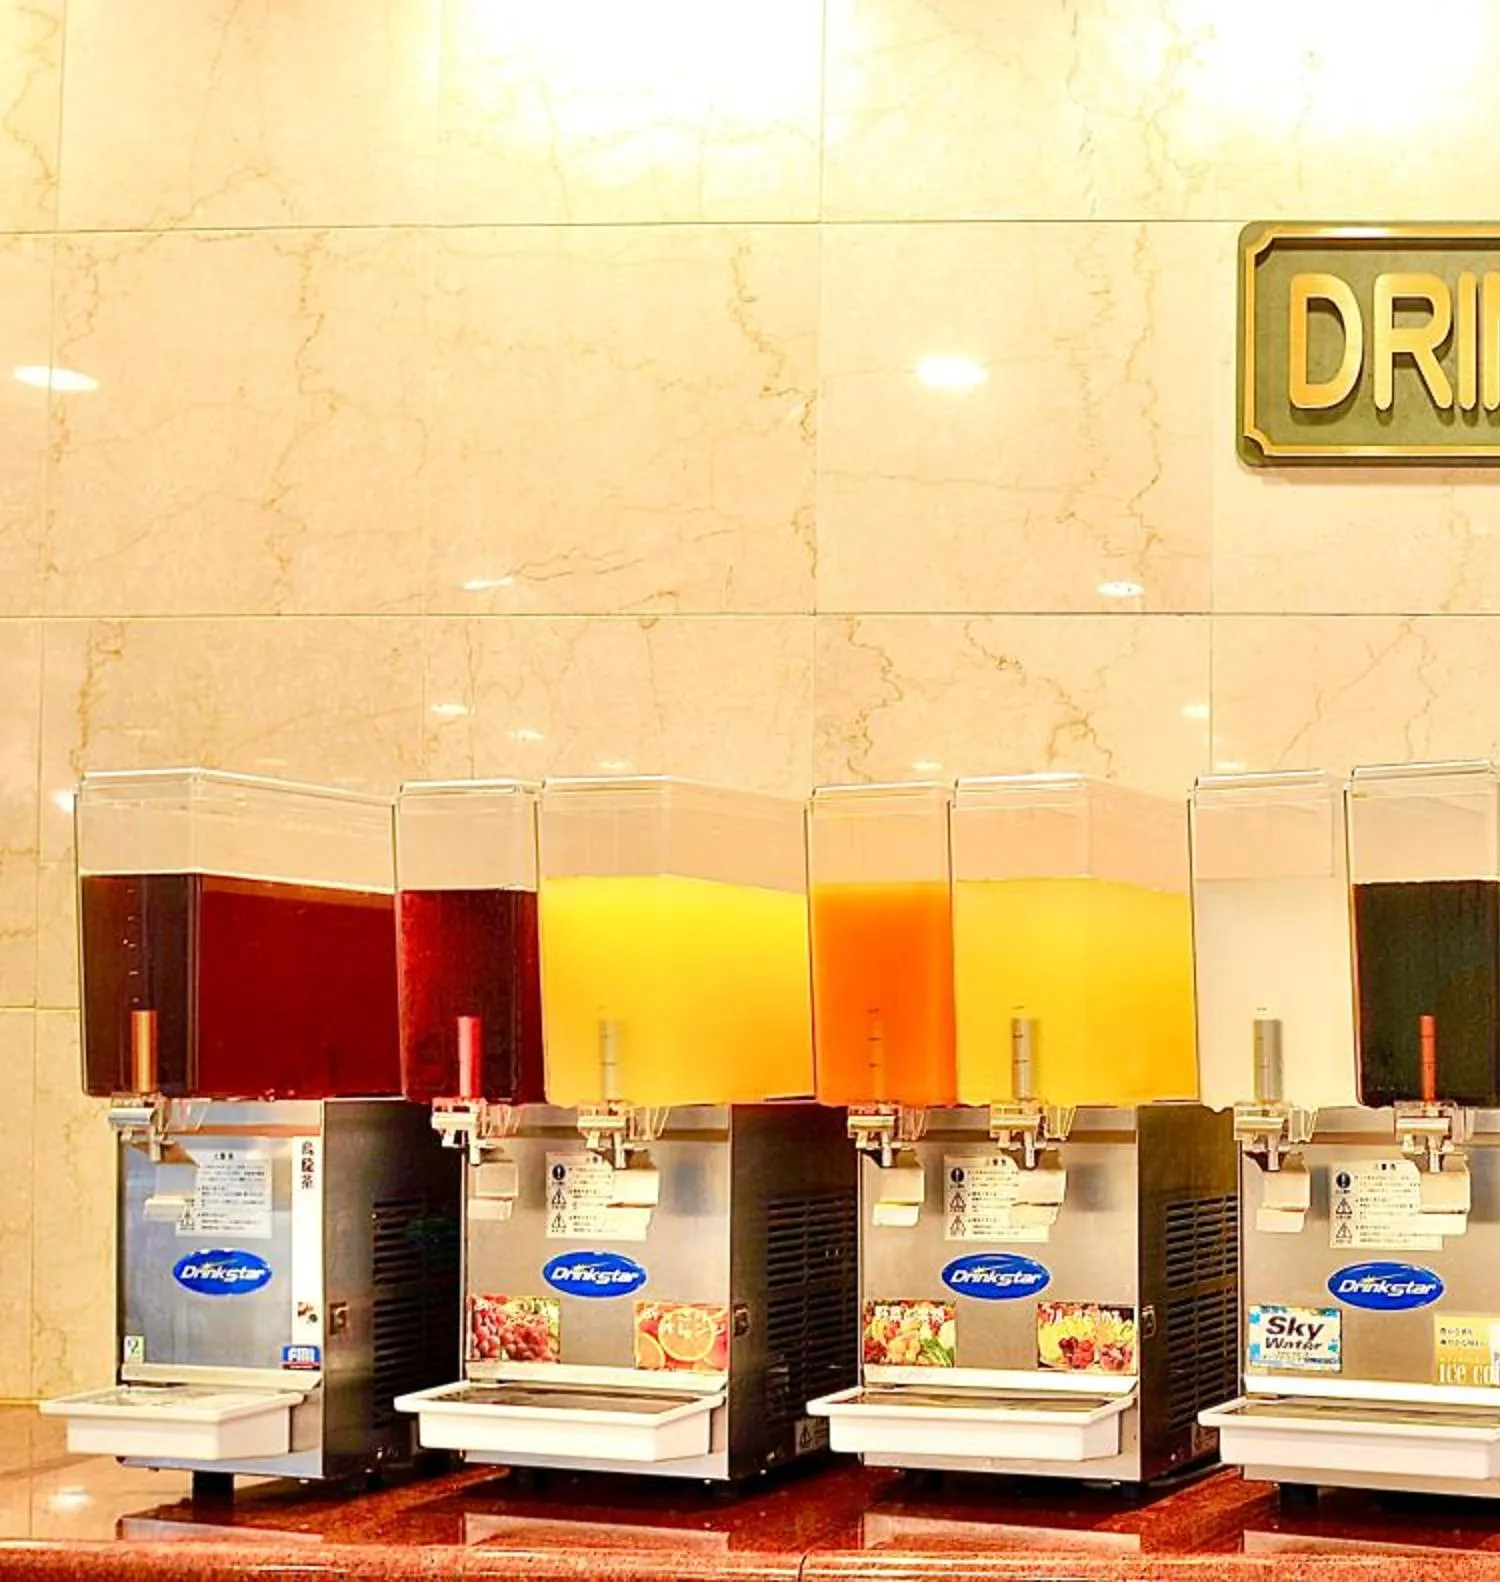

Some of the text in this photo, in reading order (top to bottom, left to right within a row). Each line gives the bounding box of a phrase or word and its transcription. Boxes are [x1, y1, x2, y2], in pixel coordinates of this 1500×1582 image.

[180, 1262, 266, 1283] Drinkstar
[550, 1264, 639, 1285] Drinkstar
[950, 1267, 1042, 1286] Drinkstar
[1337, 1278, 1437, 1297] Drinkstar
[1265, 1315, 1325, 1341] Sky
[1265, 1337, 1323, 1351] Water
[1439, 1357, 1467, 1385] ice
